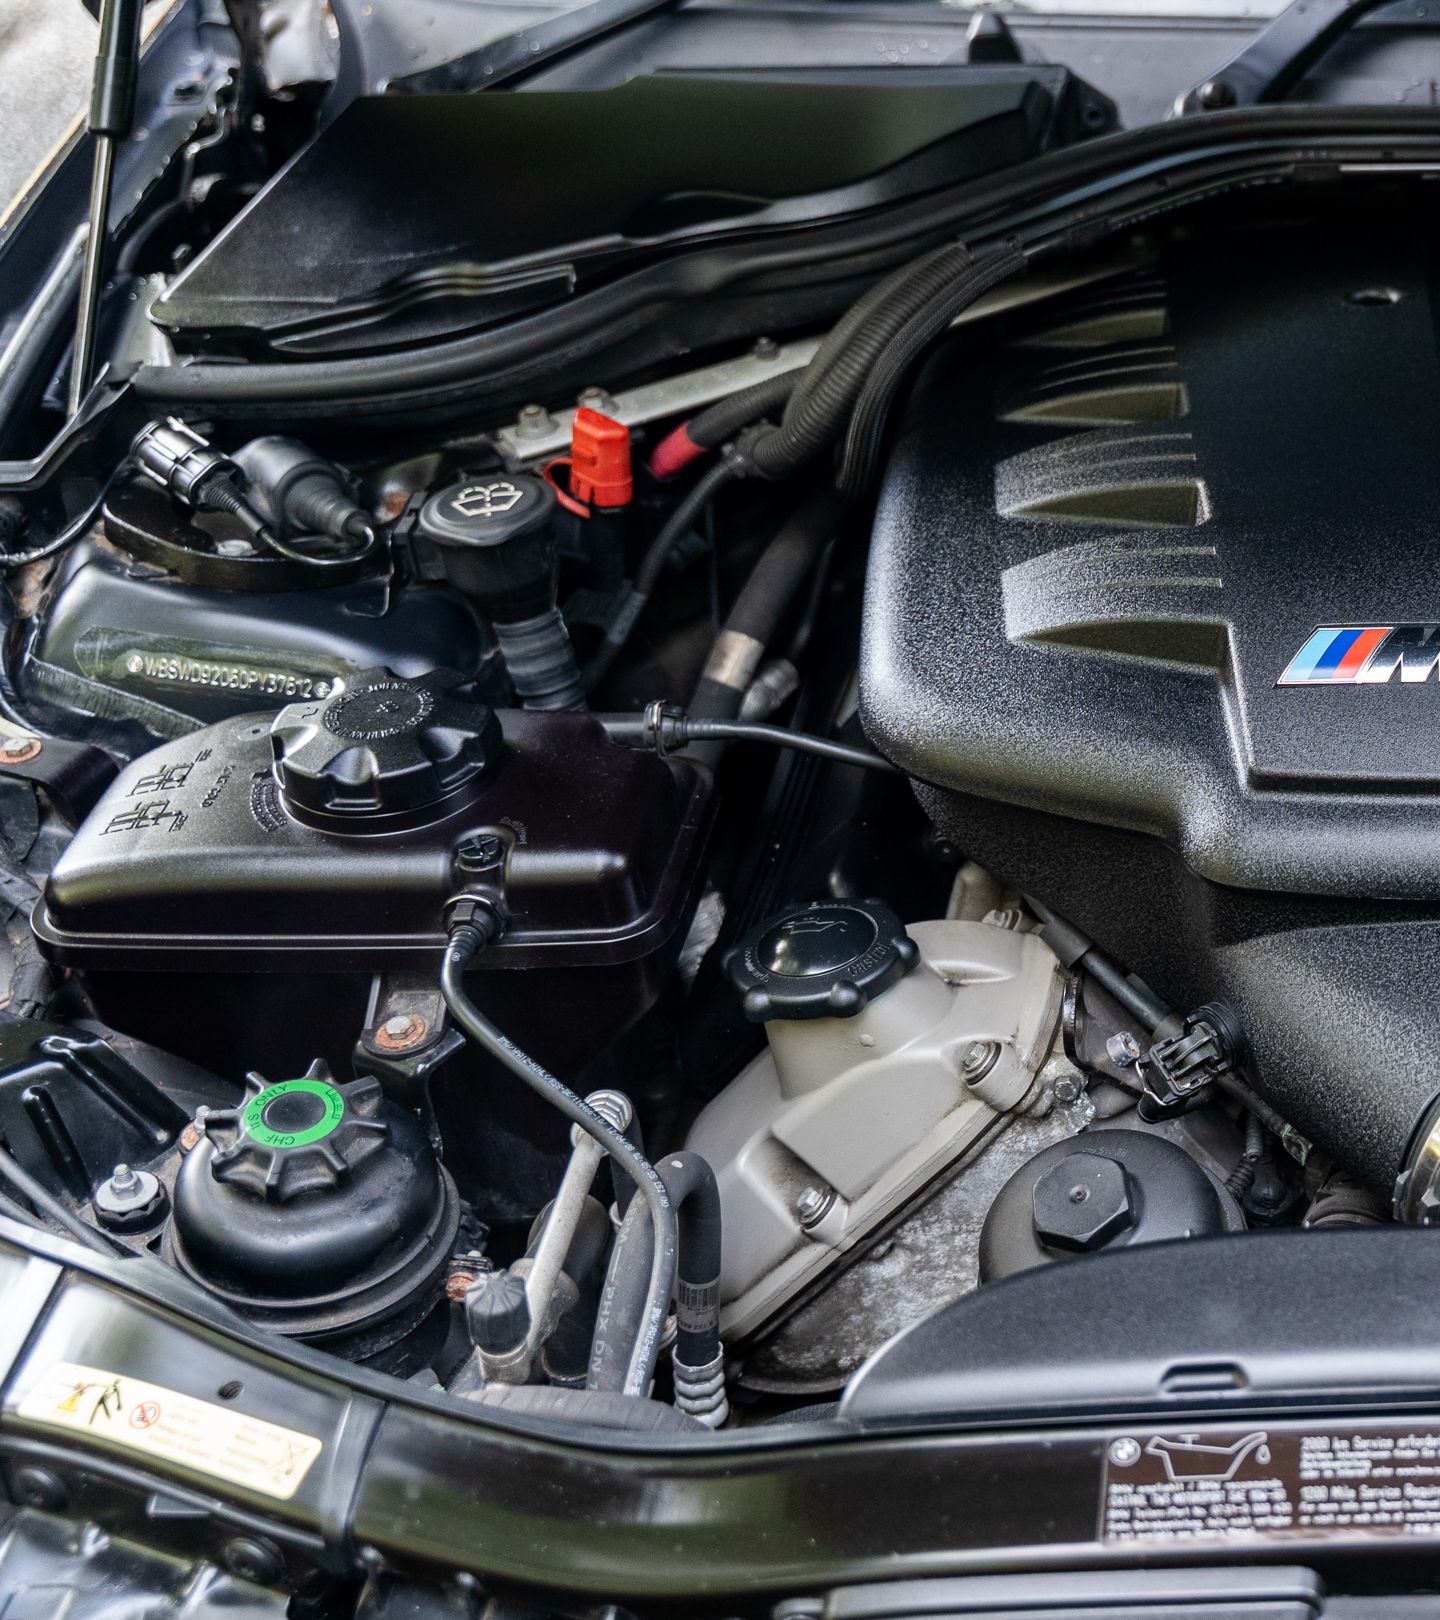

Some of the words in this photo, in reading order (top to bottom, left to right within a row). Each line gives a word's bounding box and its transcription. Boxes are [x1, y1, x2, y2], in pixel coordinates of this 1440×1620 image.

[255, 1084, 288, 1107] ONLY
[264, 1134, 296, 1146] CHF
[598, 1286, 616, 1331] PHX
[592, 1340, 606, 1373] DN
[1352, 1435, 1394, 1450] Service
[1359, 1484, 1401, 1500] Service
